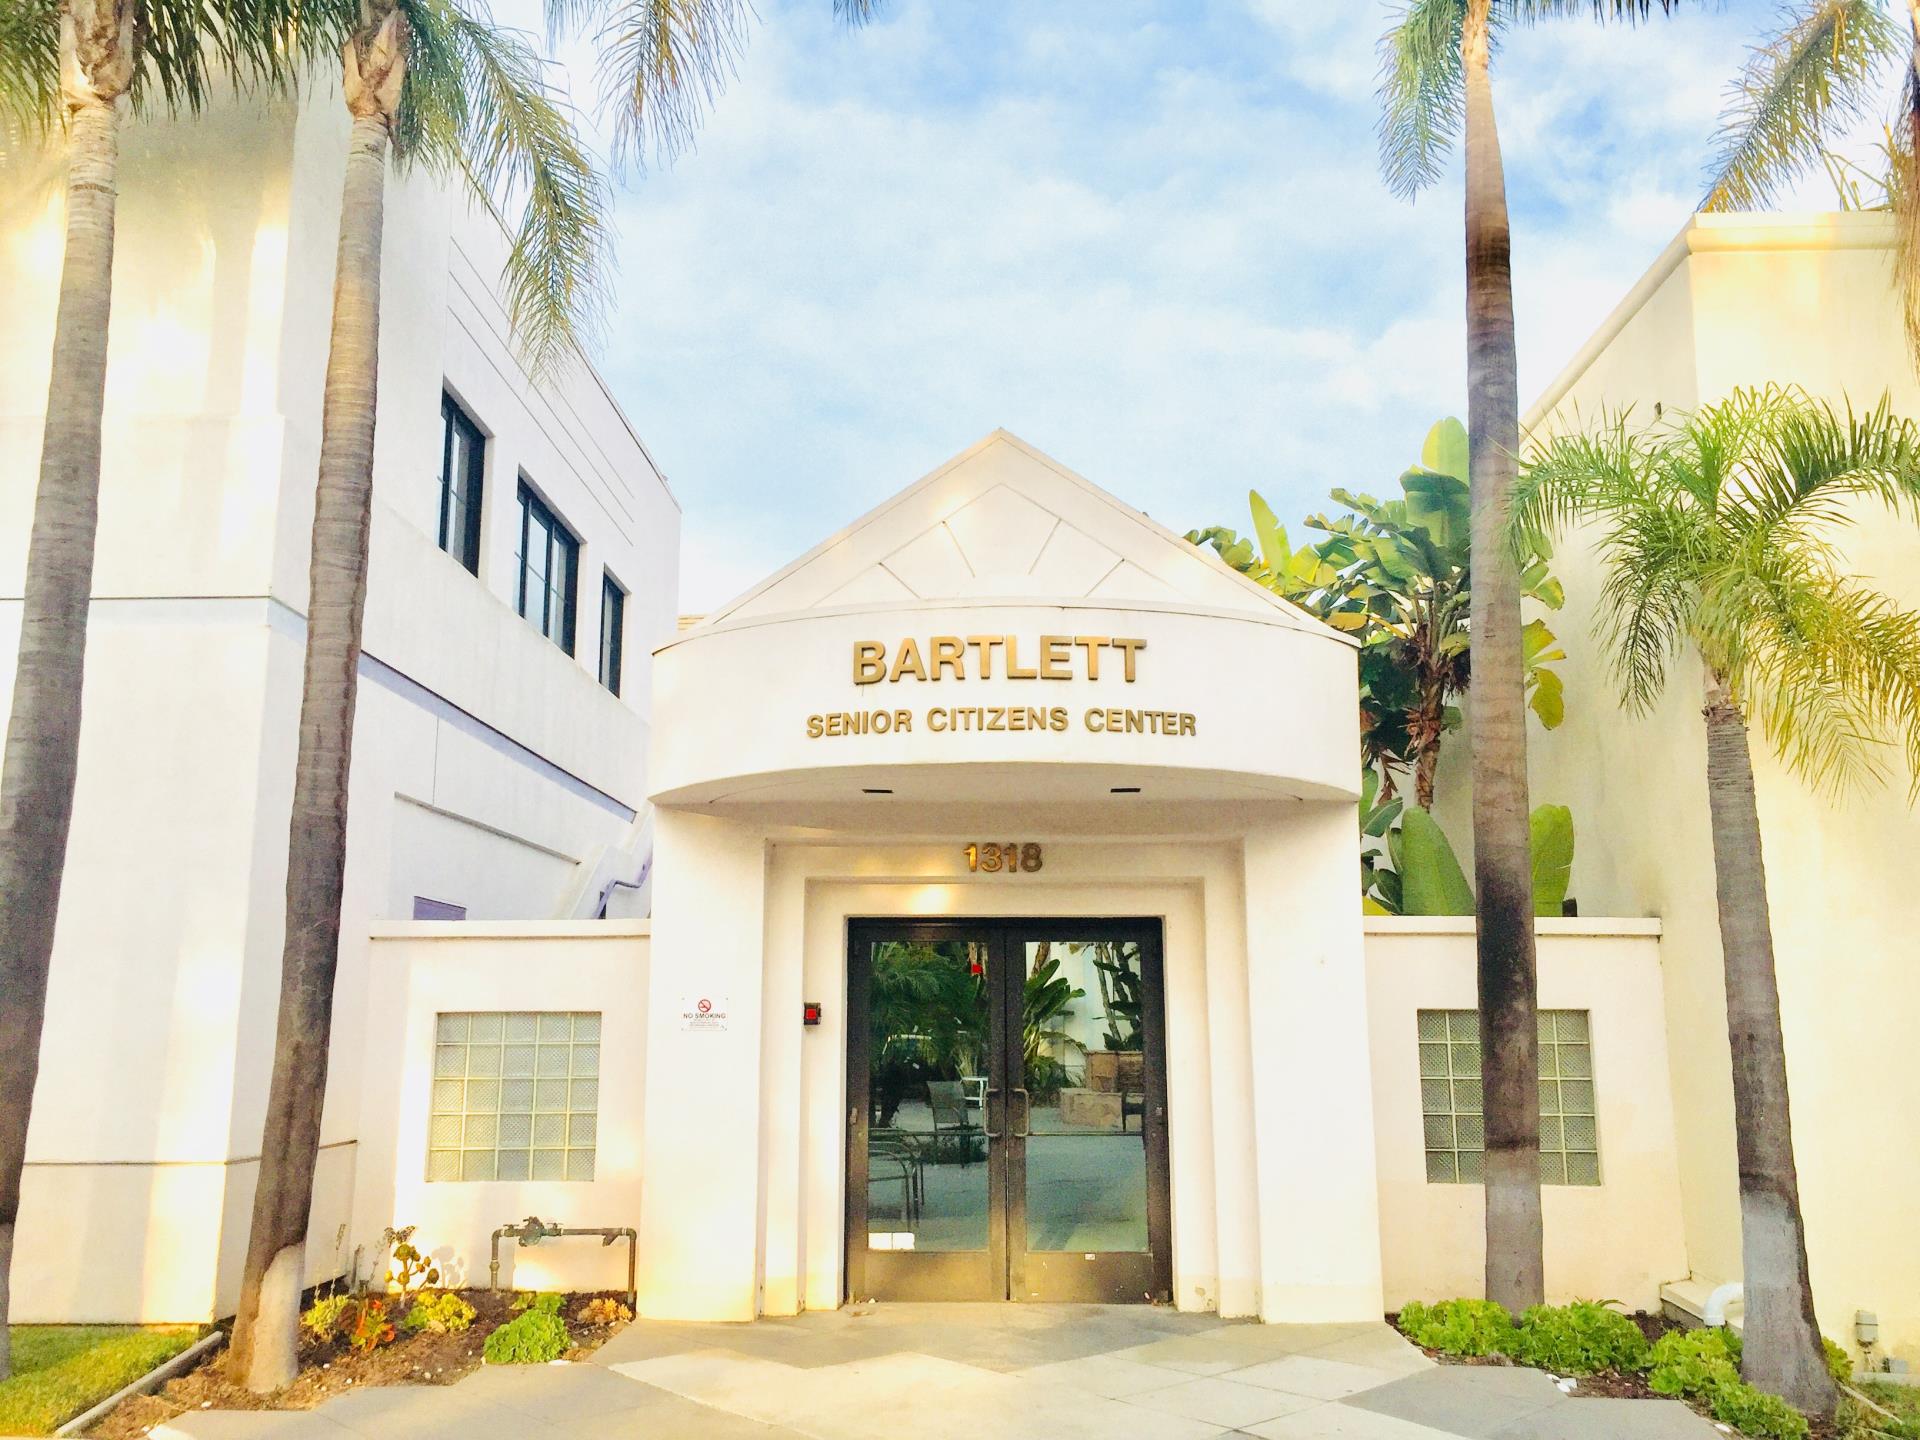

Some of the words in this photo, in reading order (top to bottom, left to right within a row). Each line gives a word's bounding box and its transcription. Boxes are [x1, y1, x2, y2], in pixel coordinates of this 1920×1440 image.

[852, 635, 1147, 685] BARTLETT
[806, 709, 913, 738] SENIOR
[926, 706, 1069, 732] CITIZENS
[1083, 707, 1197, 737] CENTER
[963, 842, 1044, 873] 1318
